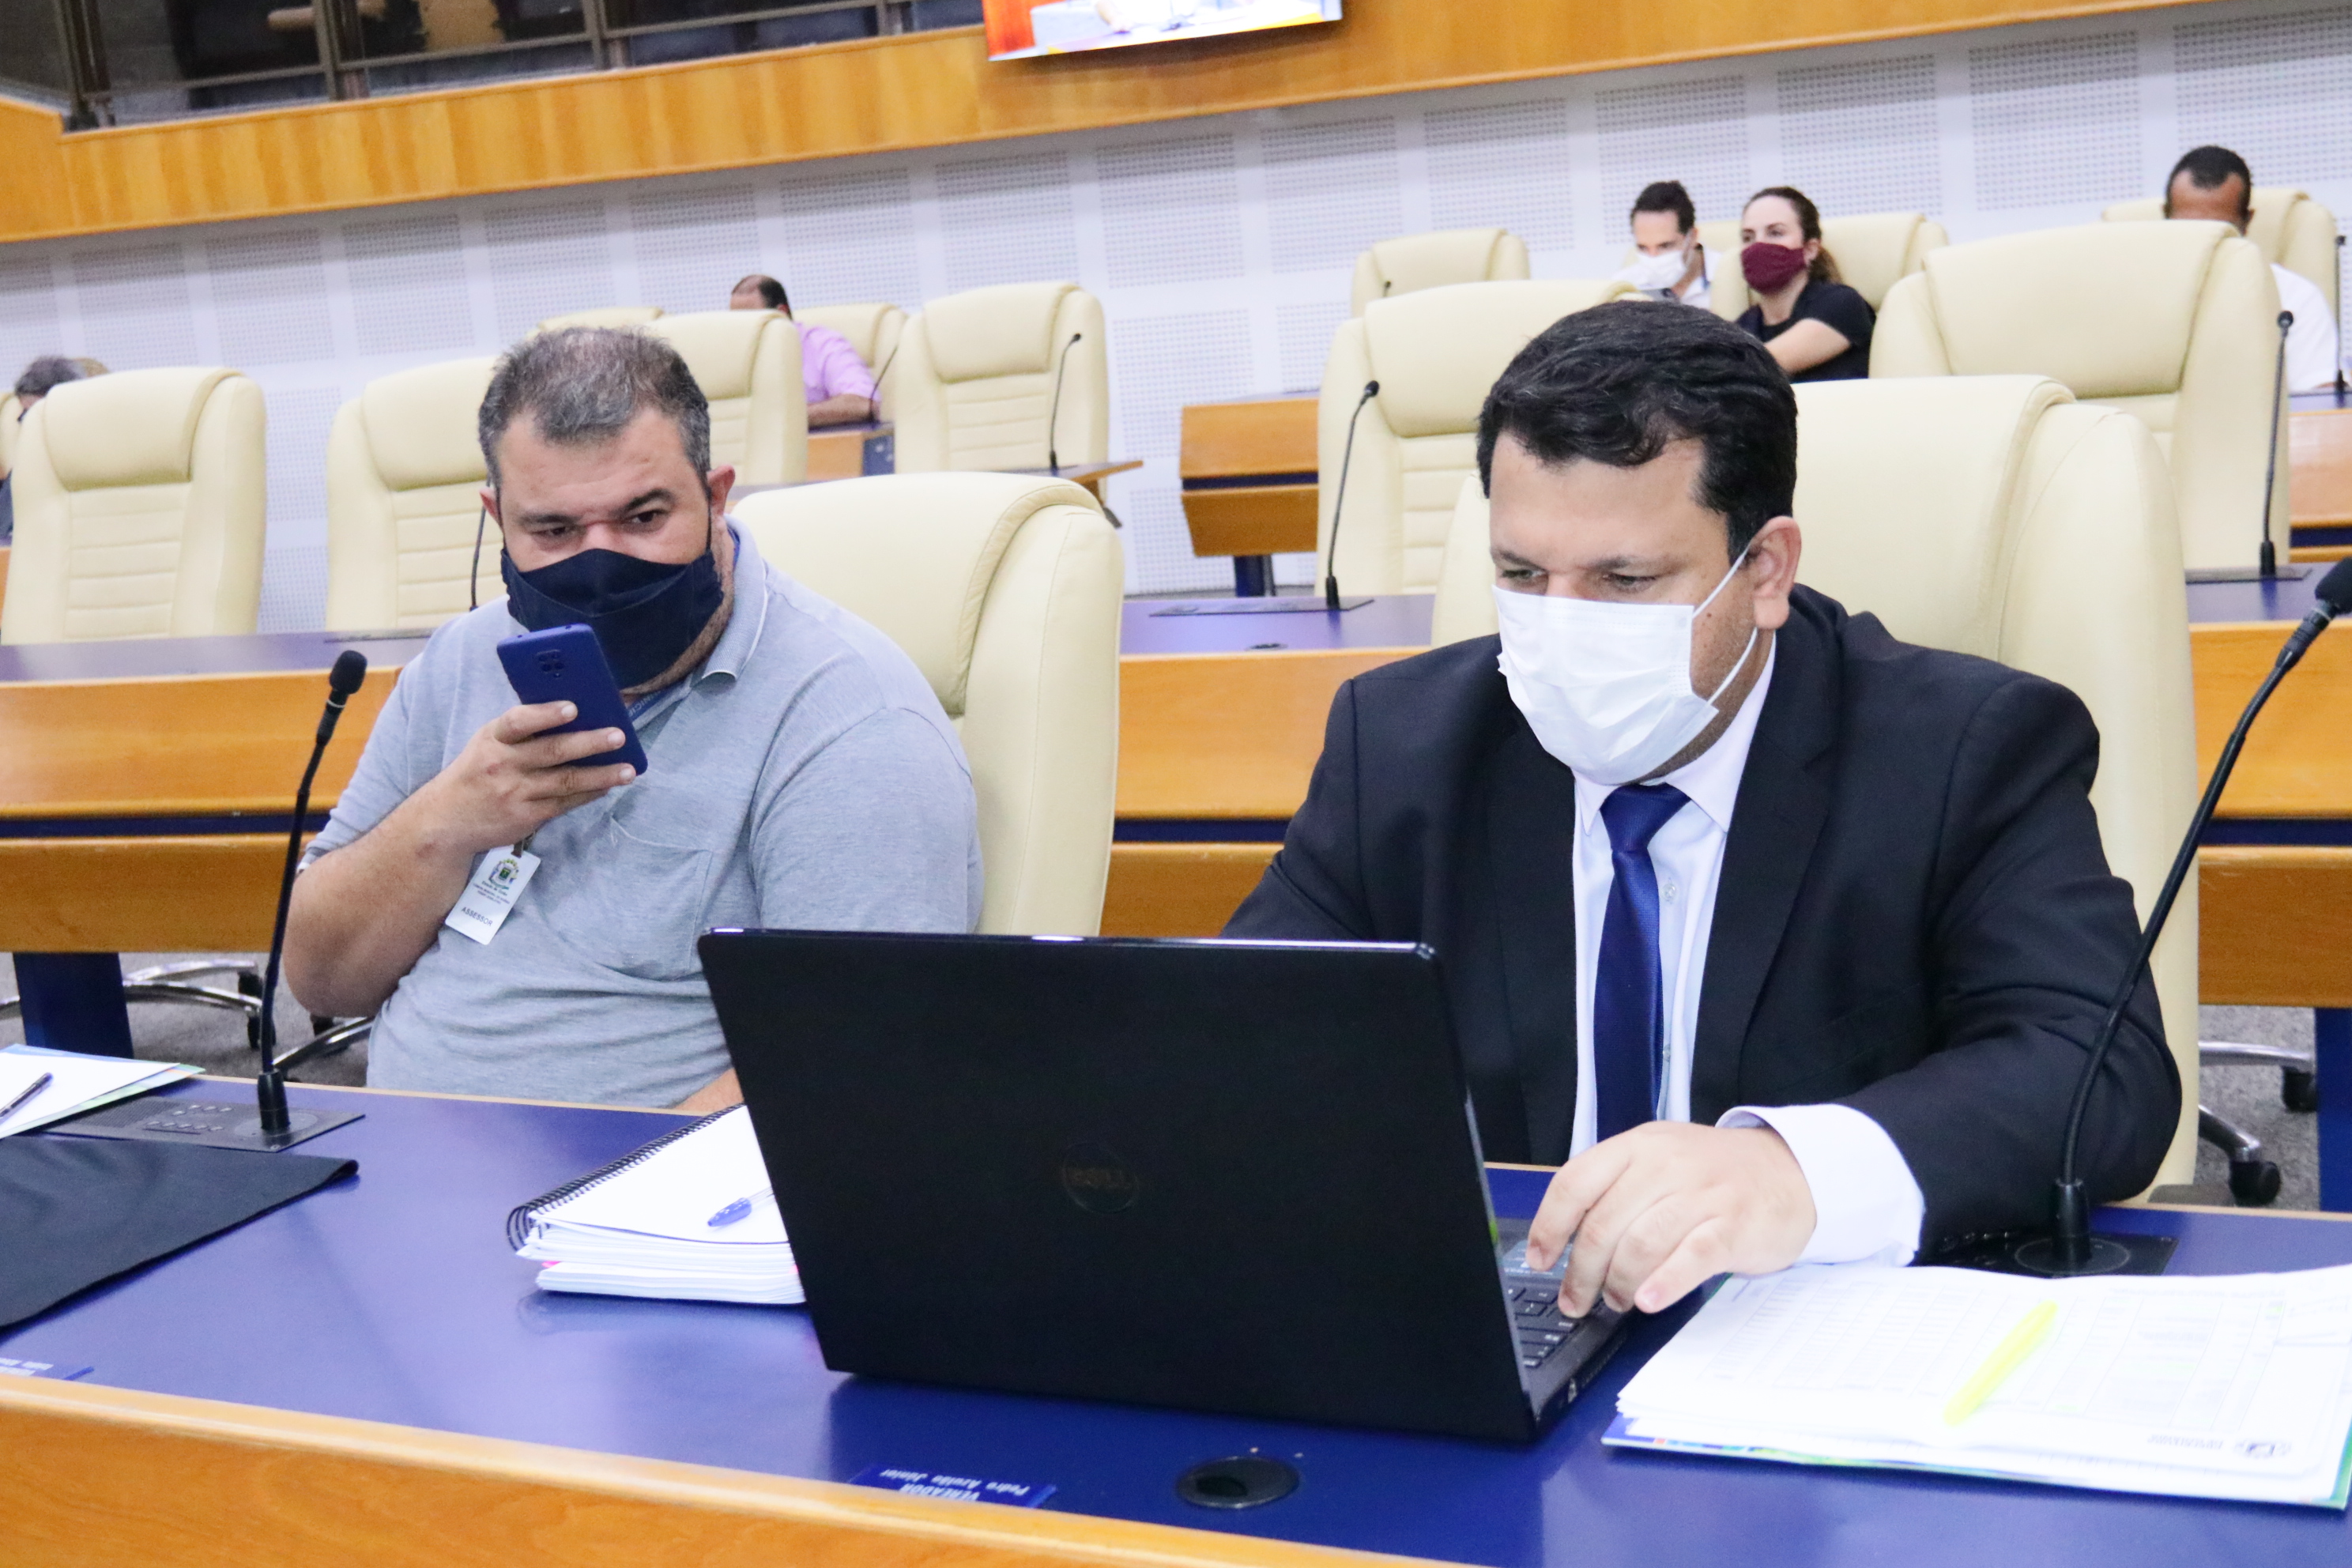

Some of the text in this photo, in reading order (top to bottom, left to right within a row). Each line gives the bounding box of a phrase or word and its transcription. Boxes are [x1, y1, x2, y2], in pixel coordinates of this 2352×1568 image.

[462, 906, 492, 926] ASSESSOR
[898, 1483, 981, 1502] VEREADOR
[985, 1481, 1030, 1496] Pedro
